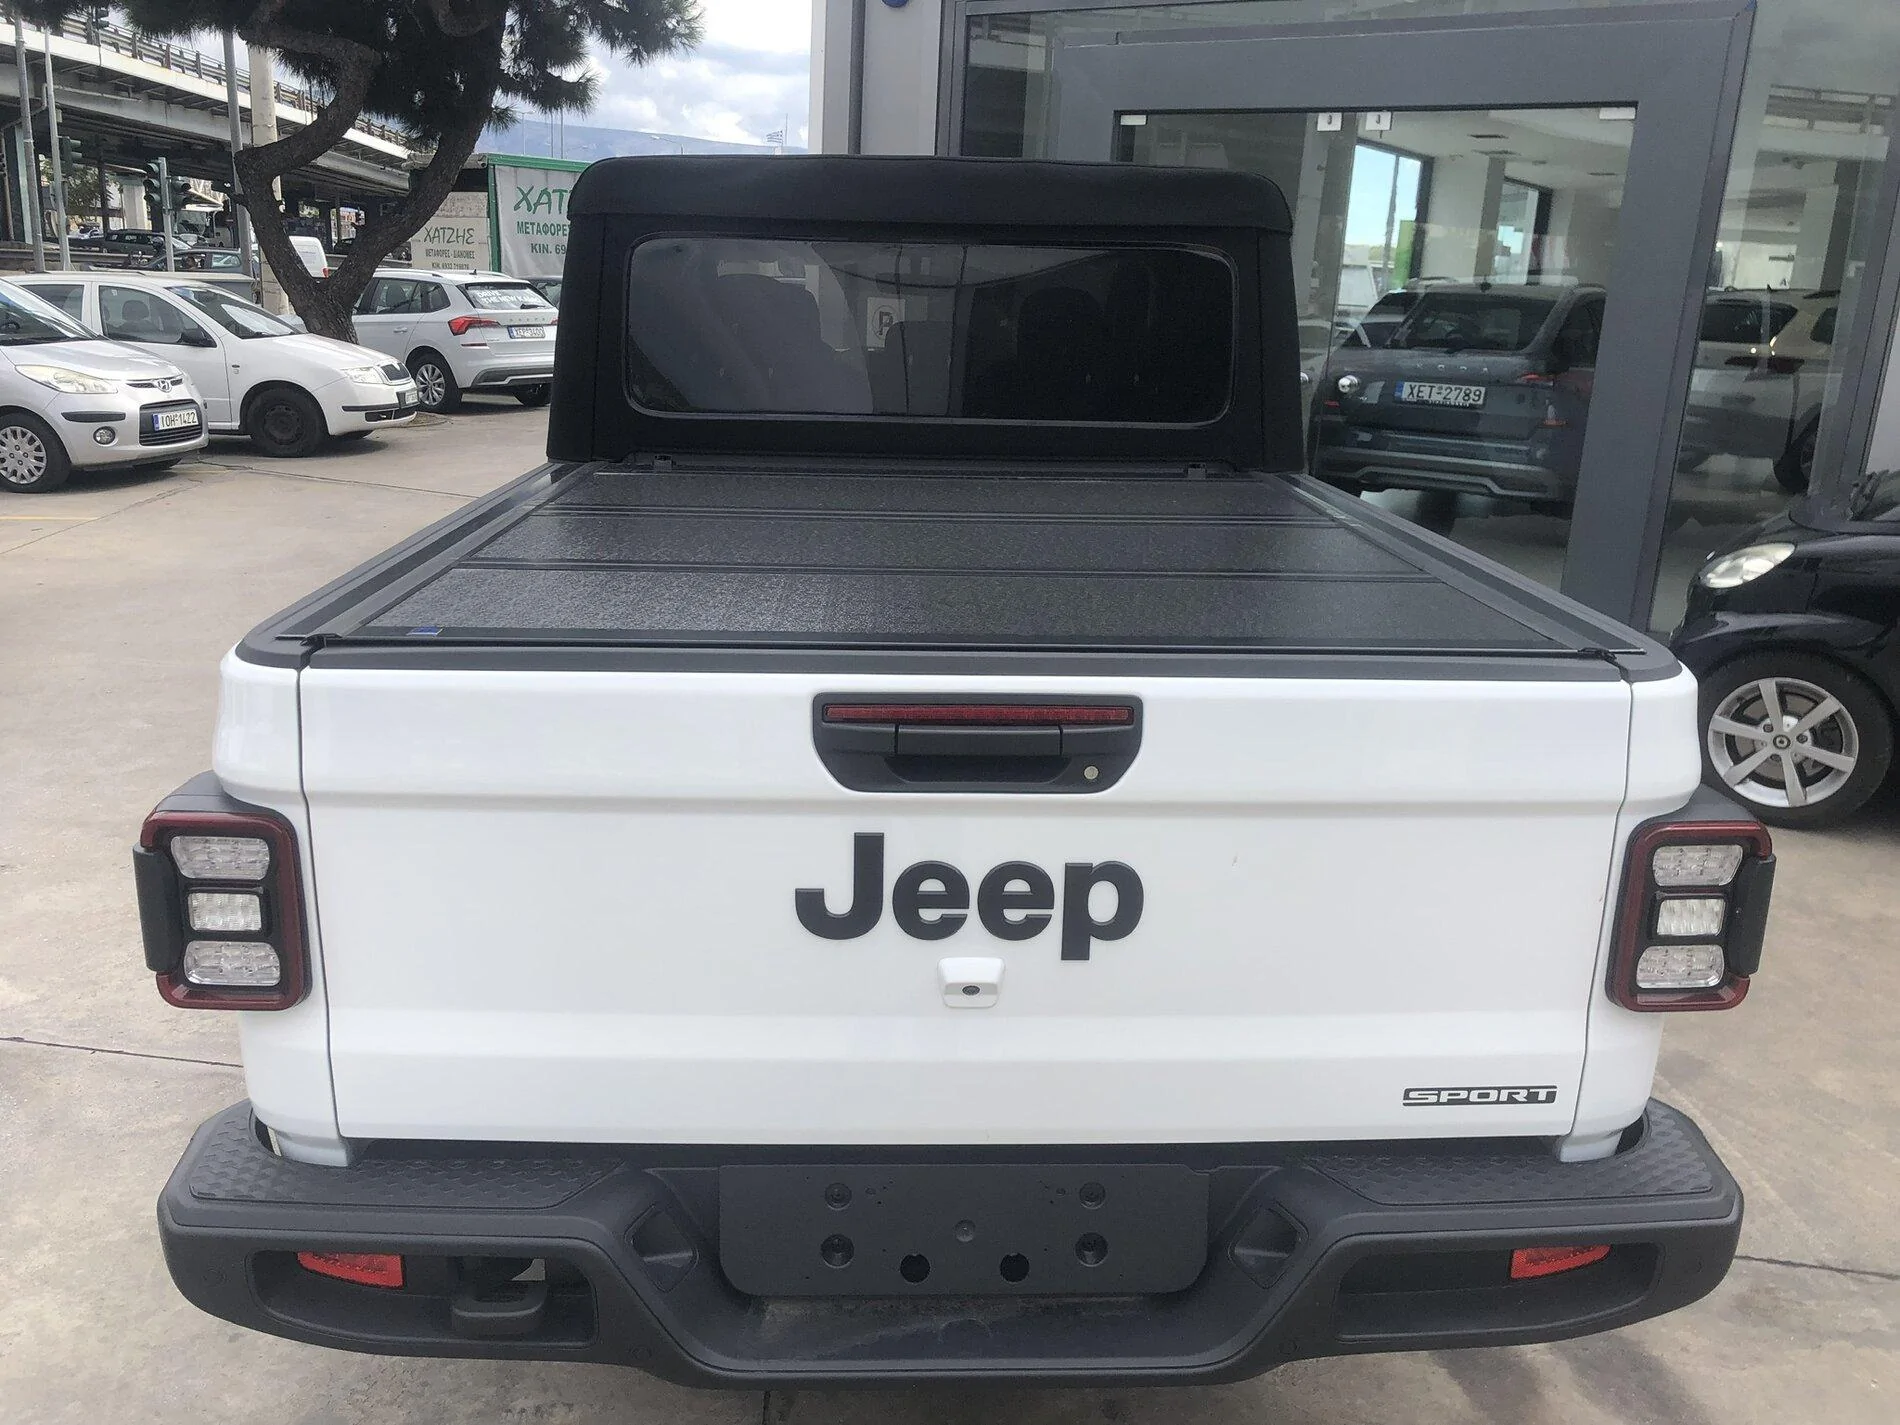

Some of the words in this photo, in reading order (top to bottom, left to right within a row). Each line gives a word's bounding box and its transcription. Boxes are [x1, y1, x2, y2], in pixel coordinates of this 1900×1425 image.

[514, 186, 572, 214] ΧΑΤ
[517, 221, 570, 236] ΜΕΤΑΦΟΡΕ
[795, 832, 1144, 961] Jeep
[1402, 1086, 1557, 1106] SPORT
